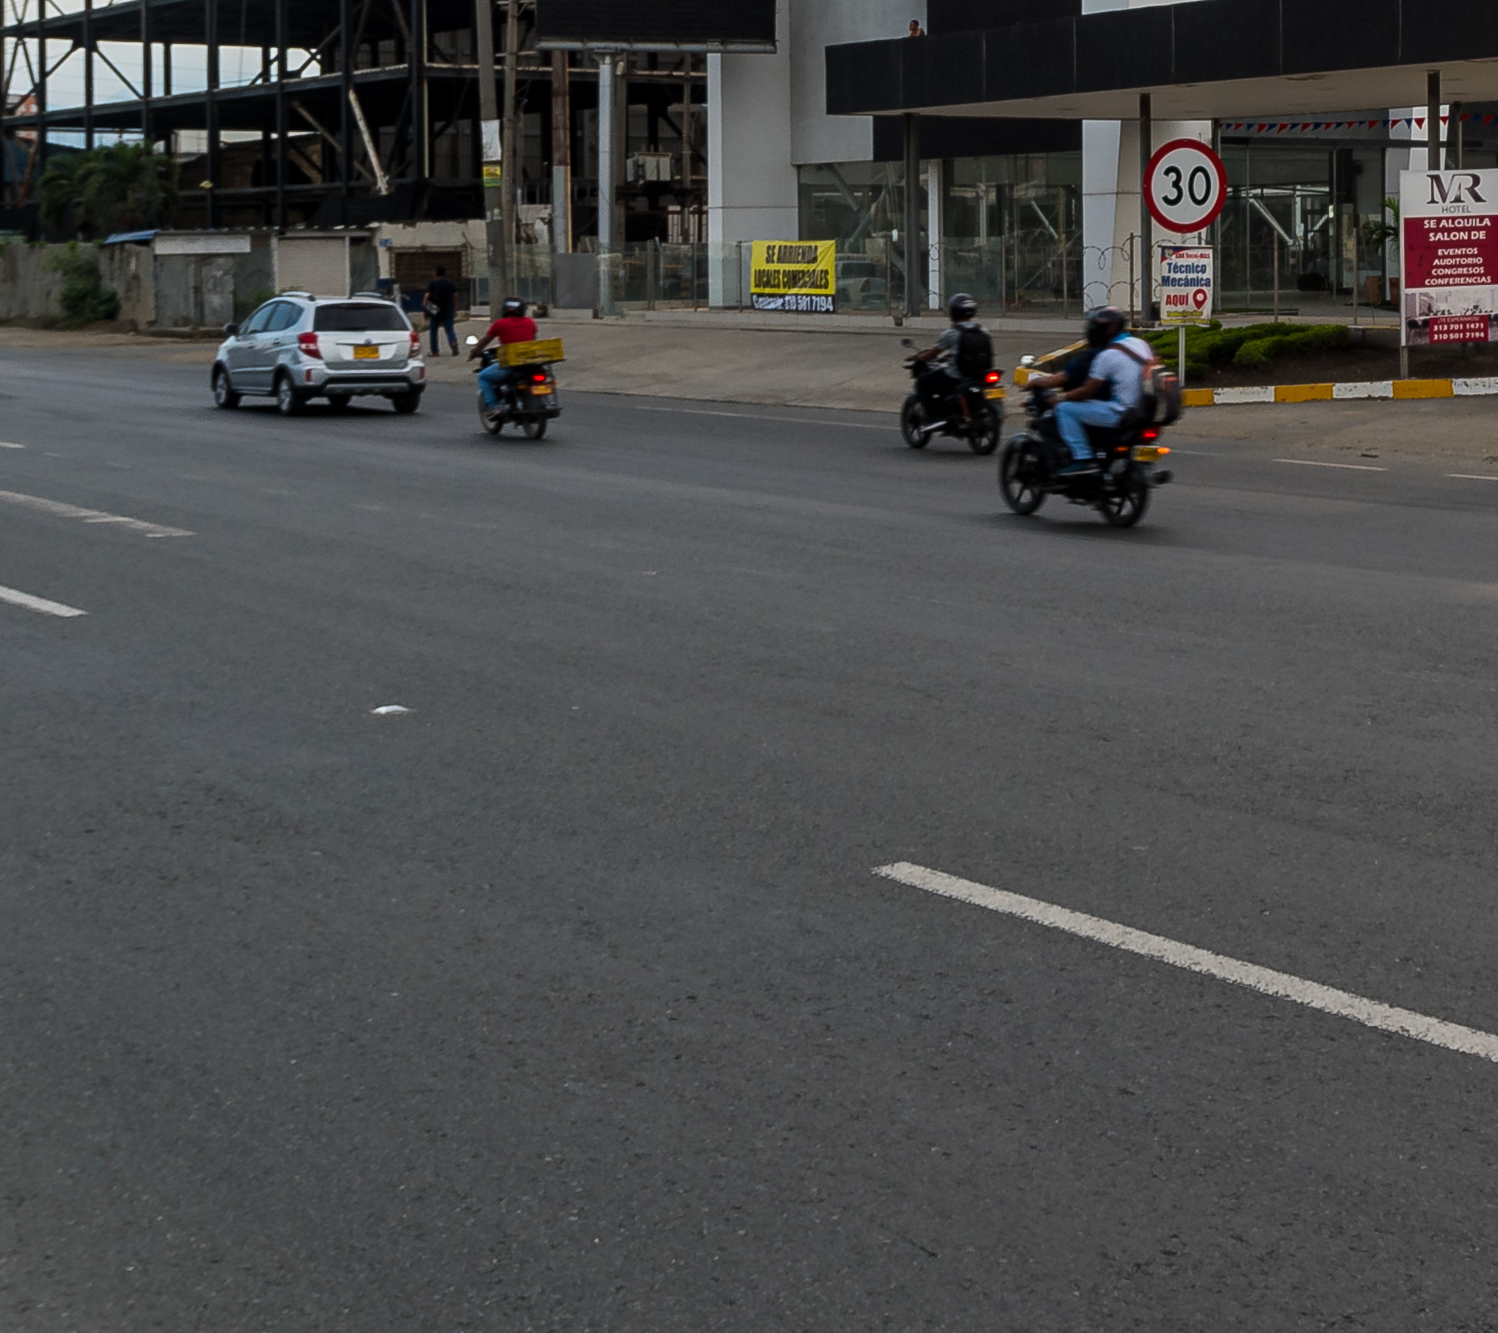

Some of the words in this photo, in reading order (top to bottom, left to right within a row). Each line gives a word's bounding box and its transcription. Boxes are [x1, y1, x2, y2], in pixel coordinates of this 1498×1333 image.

[1162, 165, 1212, 206] 30
[1426, 173, 1487, 204] MR
[1442, 205, 1471, 213] HOTEL
[1423, 219, 1437, 228] SE
[1439, 218, 1491, 228] ALQUILA
[1429, 231, 1468, 241] SALON
[1471, 231, 1486, 240] DE
[766, 245, 776, 264] SE
[777, 245, 818, 264] ARRIENDA
[1437, 247, 1478, 256] EVENTOS
[1432, 257, 1483, 266] AUDITORIO
[1167, 262, 1207, 274] Técnico
[1431, 267, 1485, 276] CONGRESOS
[754, 268, 781, 289] LOCALES
[1161, 275, 1211, 287] Mecánica
[1424, 276, 1492, 286] CONFERENCIAS
[812, 296, 834, 311] 7194
[1433, 333, 1448, 341] 310
